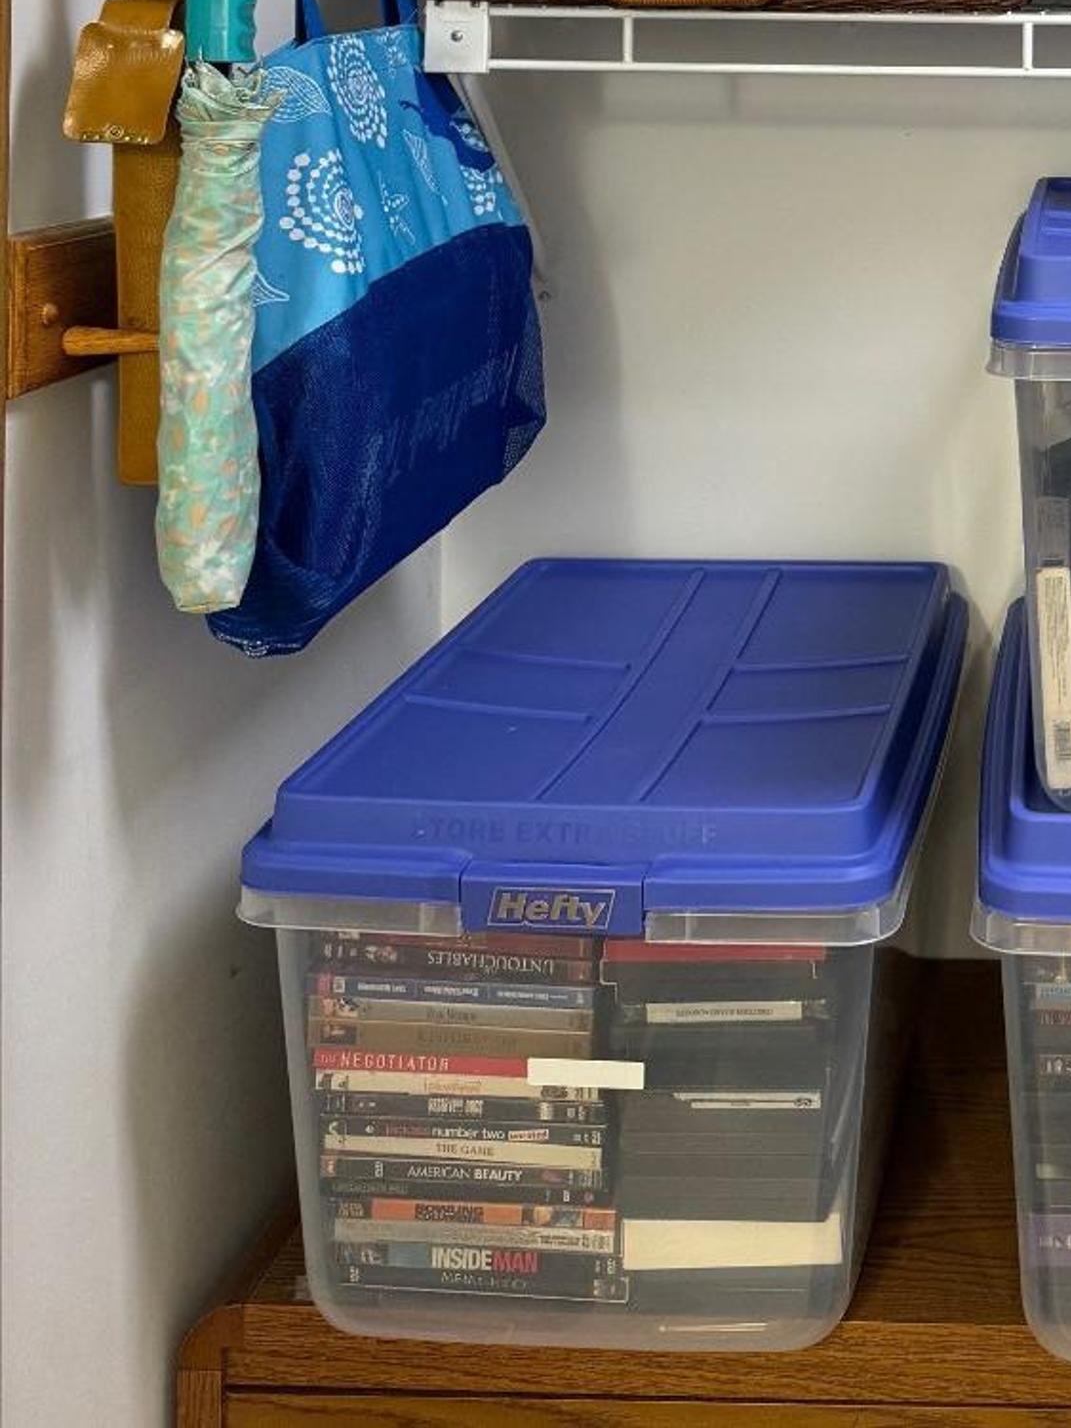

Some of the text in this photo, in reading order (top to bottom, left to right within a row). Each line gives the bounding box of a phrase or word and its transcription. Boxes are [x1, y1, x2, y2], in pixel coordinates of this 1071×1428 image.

[499, 892, 606, 927] Hefty
[340, 1053, 449, 1072] NEGOTIATOR
[431, 1127, 479, 1140] number
[482, 1128, 506, 1141] two
[436, 1143, 457, 1154] THE
[407, 1165, 523, 1182] AMERICAN BEAUTY
[431, 1245, 539, 1274] INSIDE MAN
